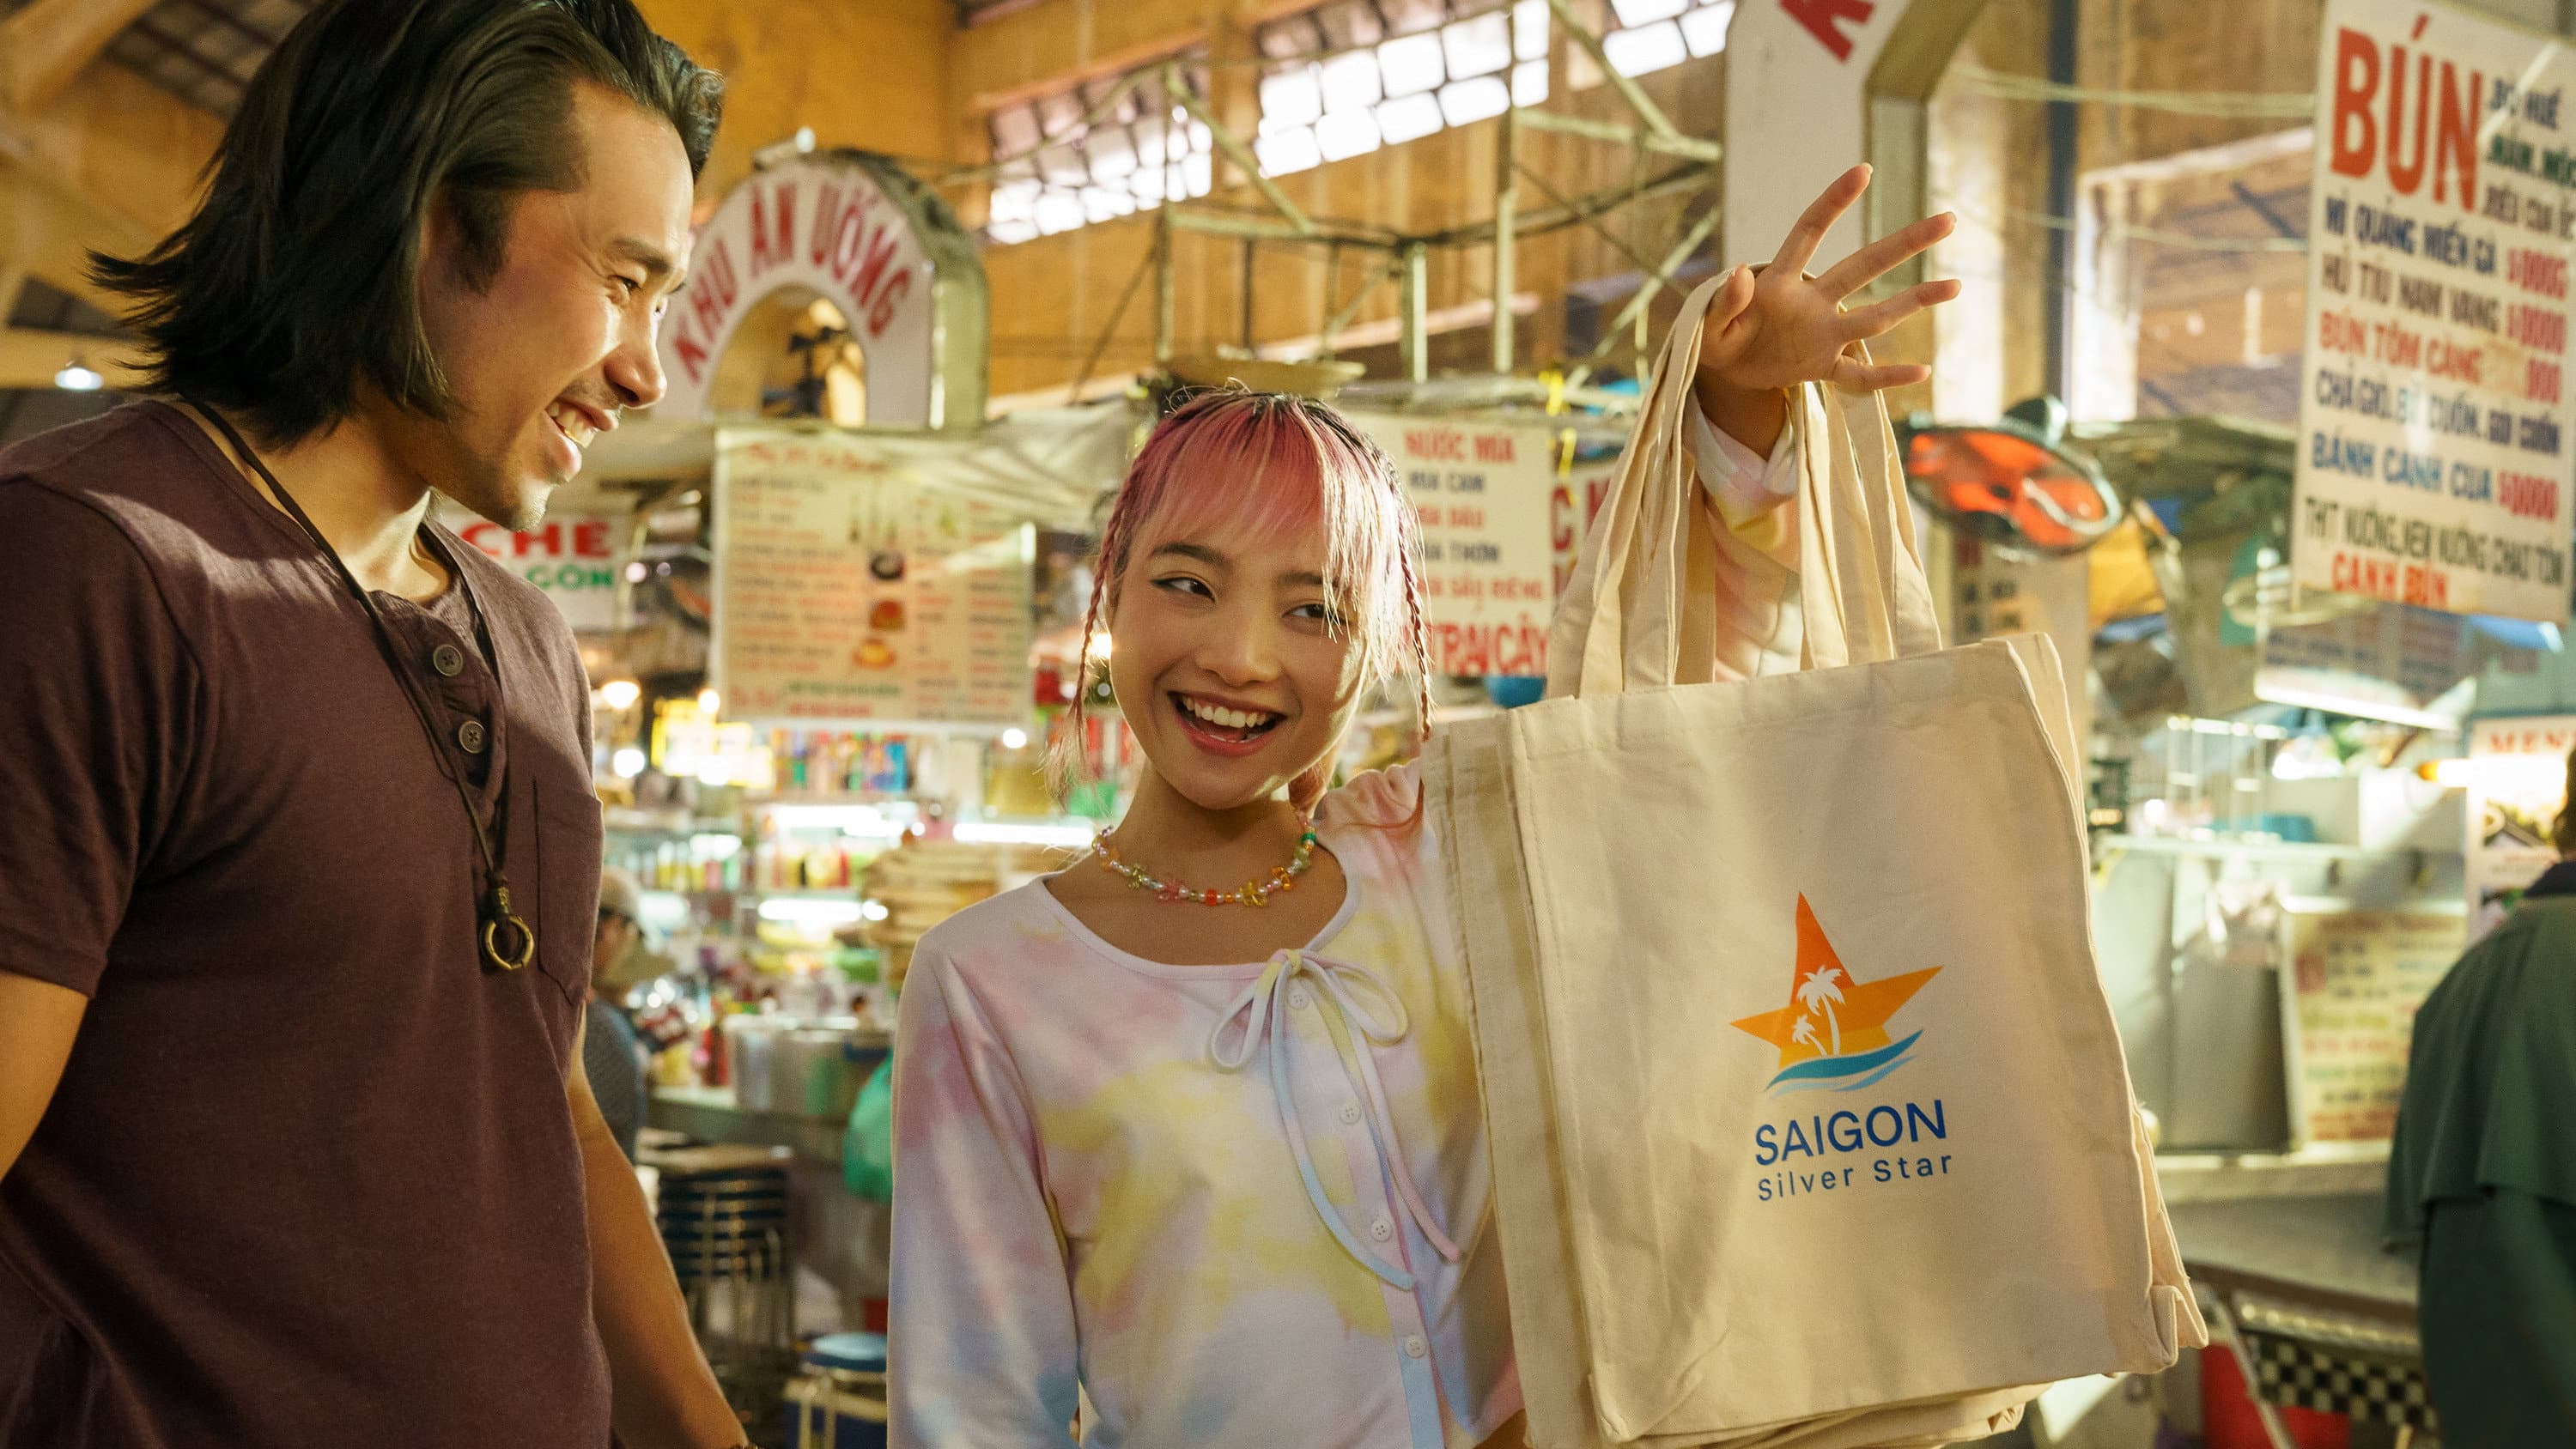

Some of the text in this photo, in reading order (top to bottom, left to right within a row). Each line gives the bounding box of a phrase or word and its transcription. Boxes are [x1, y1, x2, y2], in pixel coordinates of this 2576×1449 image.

[2330, 13, 2483, 214] BÚN
[672, 238, 741, 385] KHU
[1755, 1100, 1947, 1167] SAIGON
[1758, 1155, 1953, 1202] Silver Star
